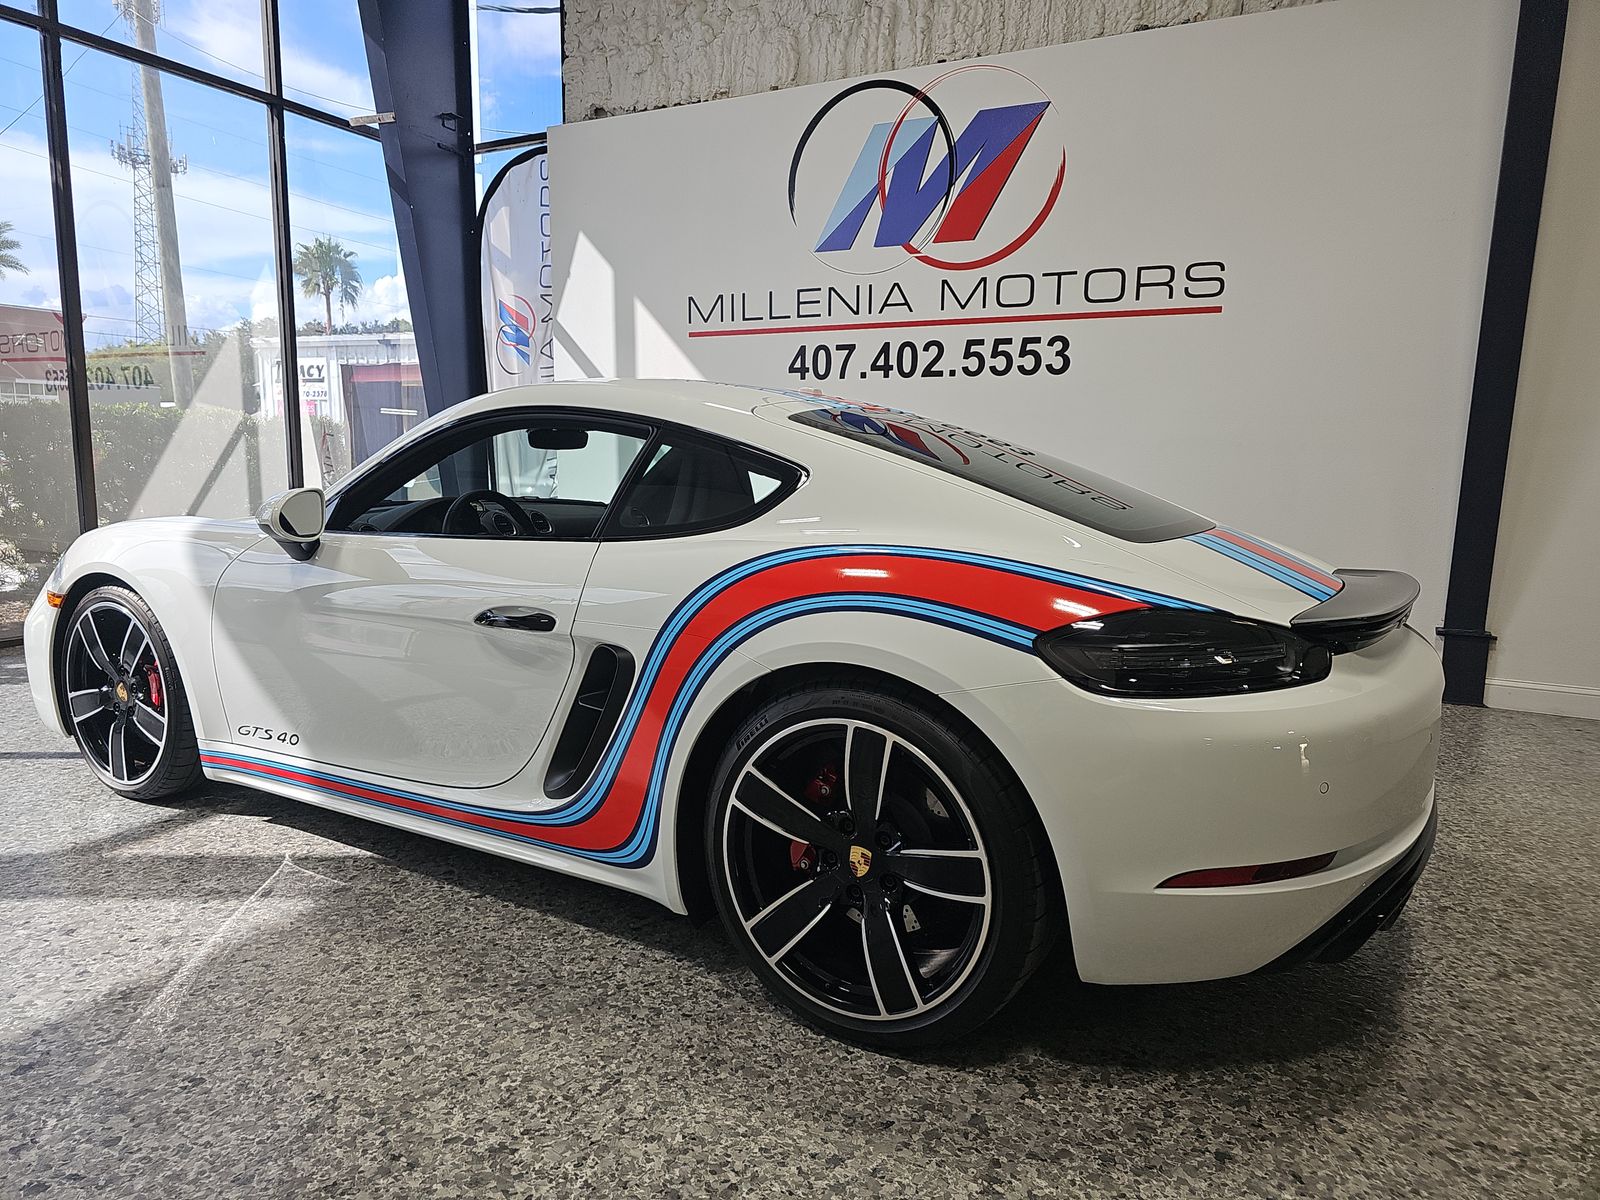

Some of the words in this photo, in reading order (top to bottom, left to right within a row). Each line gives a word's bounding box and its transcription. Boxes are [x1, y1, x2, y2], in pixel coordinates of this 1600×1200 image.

[687, 281, 914, 325] MILLENIA
[940, 260, 1226, 312] MOTORS
[788, 334, 1072, 381] 407.402.5553
[237, 725, 274, 741] GTS
[276, 731, 300, 746] 4.0
